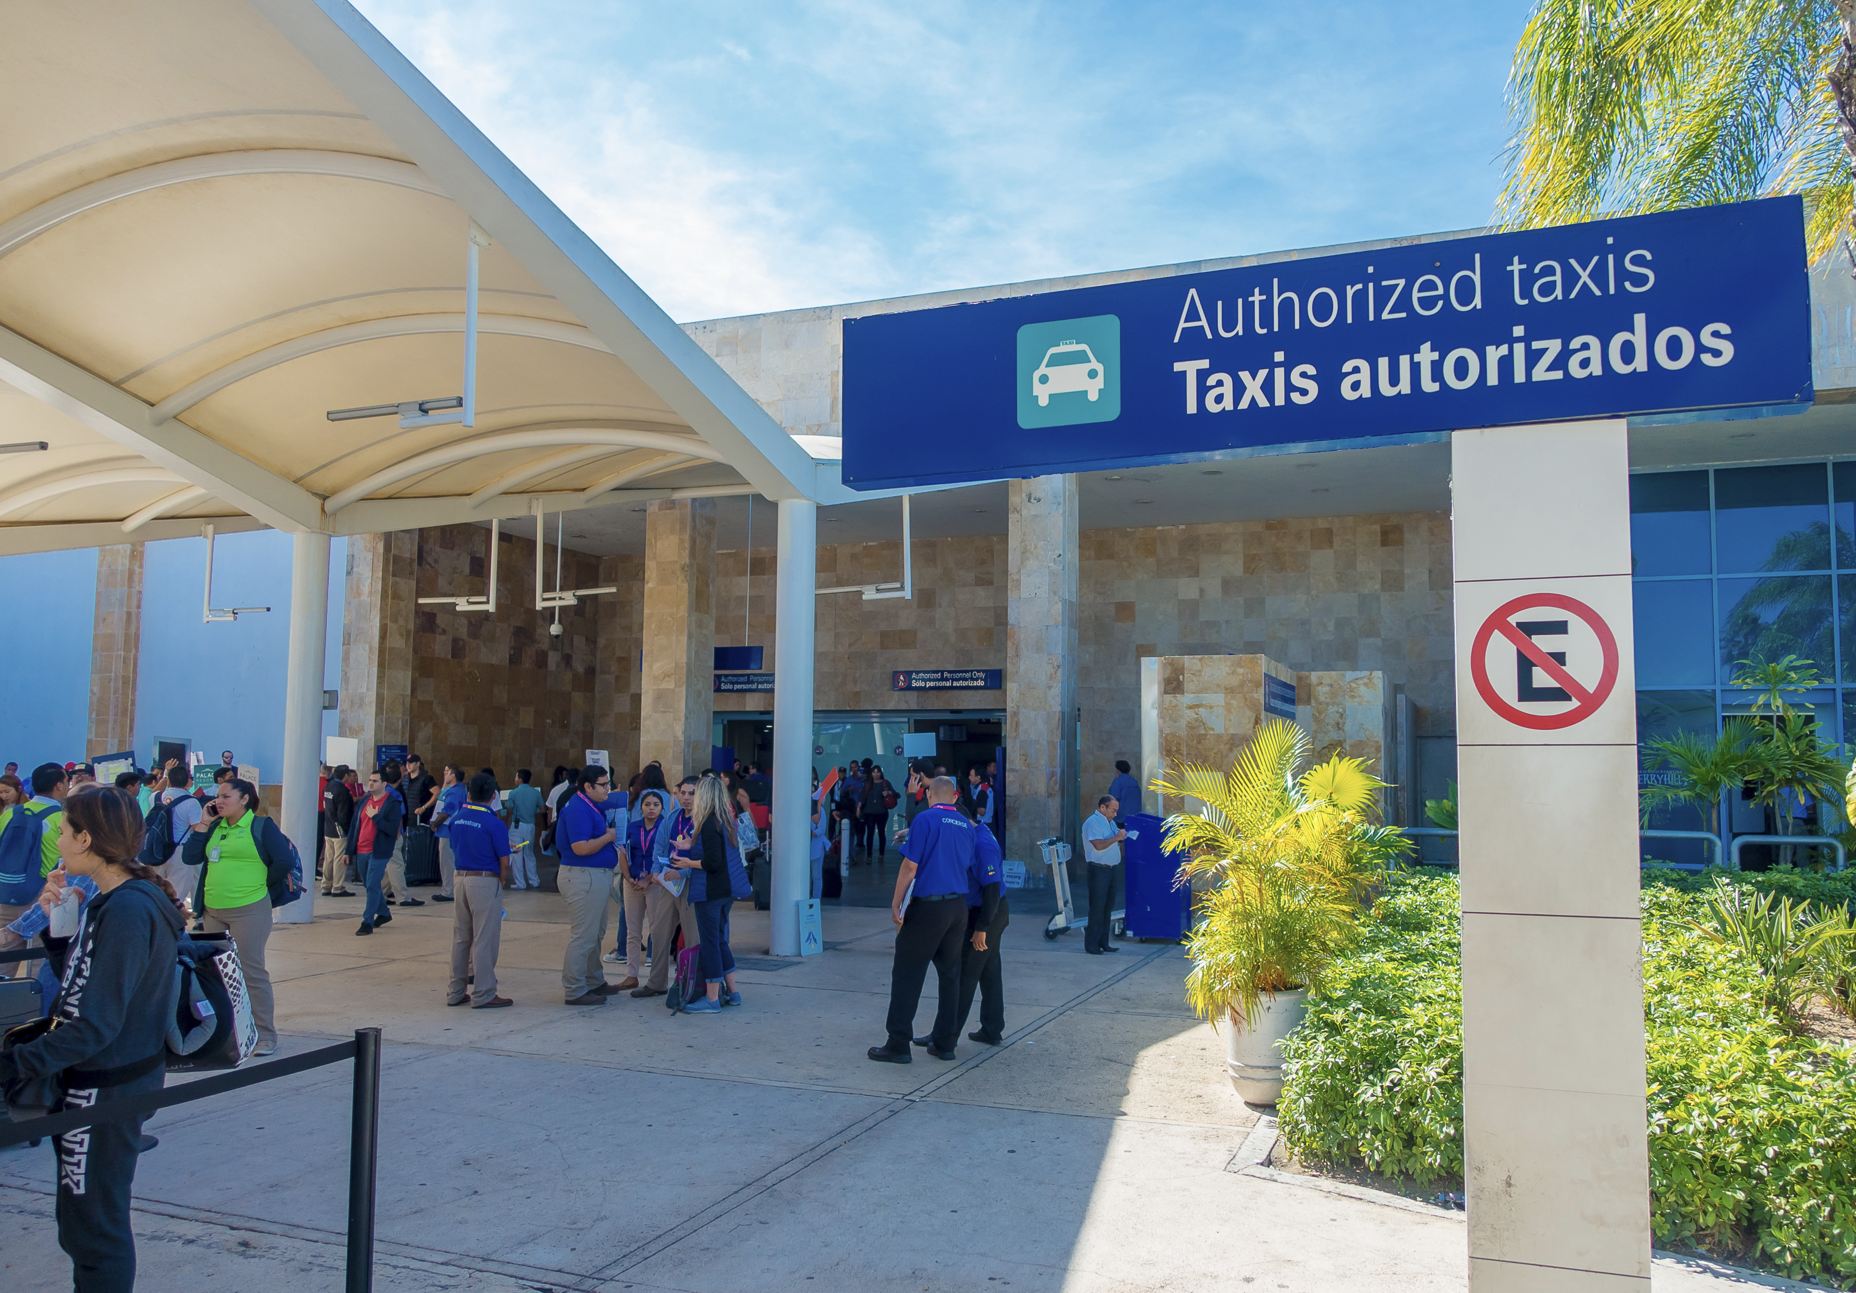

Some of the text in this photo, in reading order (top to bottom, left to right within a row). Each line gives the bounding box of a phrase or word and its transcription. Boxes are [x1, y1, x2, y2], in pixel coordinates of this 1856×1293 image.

[1173, 236, 1656, 343] Authorized taxis
[1173, 312, 1735, 415] Taxis autorizados
[1515, 619, 1573, 703] E
[911, 671, 986, 680] Authorized Personnel Only
[733, 682, 757, 690] personal
[926, 680, 952, 688] personal
[952, 679, 985, 687] autorizado
[1638, 772, 1683, 785] ERRYHILL
